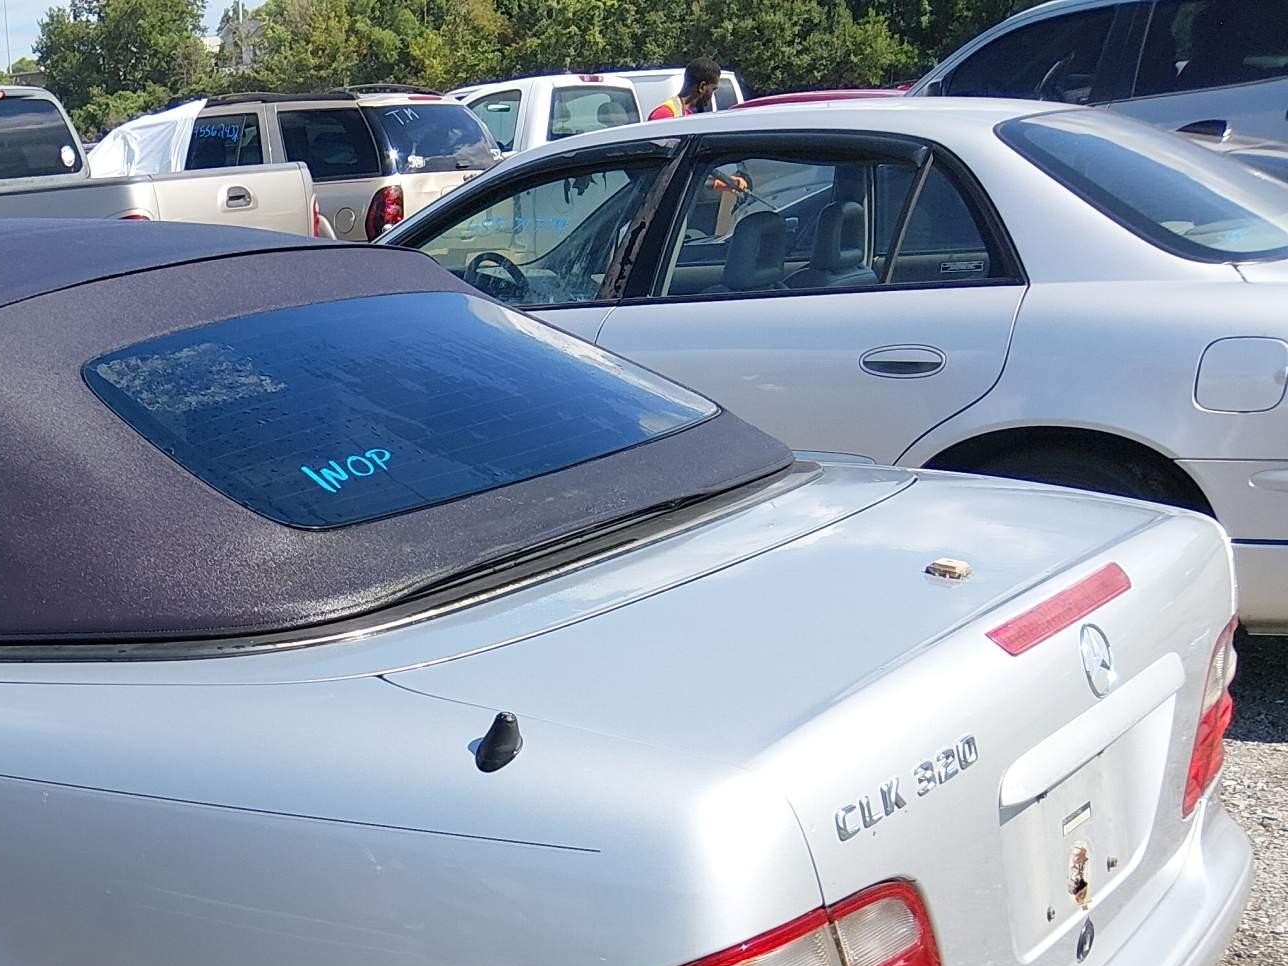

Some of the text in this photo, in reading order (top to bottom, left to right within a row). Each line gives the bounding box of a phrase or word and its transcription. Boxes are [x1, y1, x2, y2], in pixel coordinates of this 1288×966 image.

[300, 448, 391, 493] INOP
[834, 734, 978, 842] CLK 320
